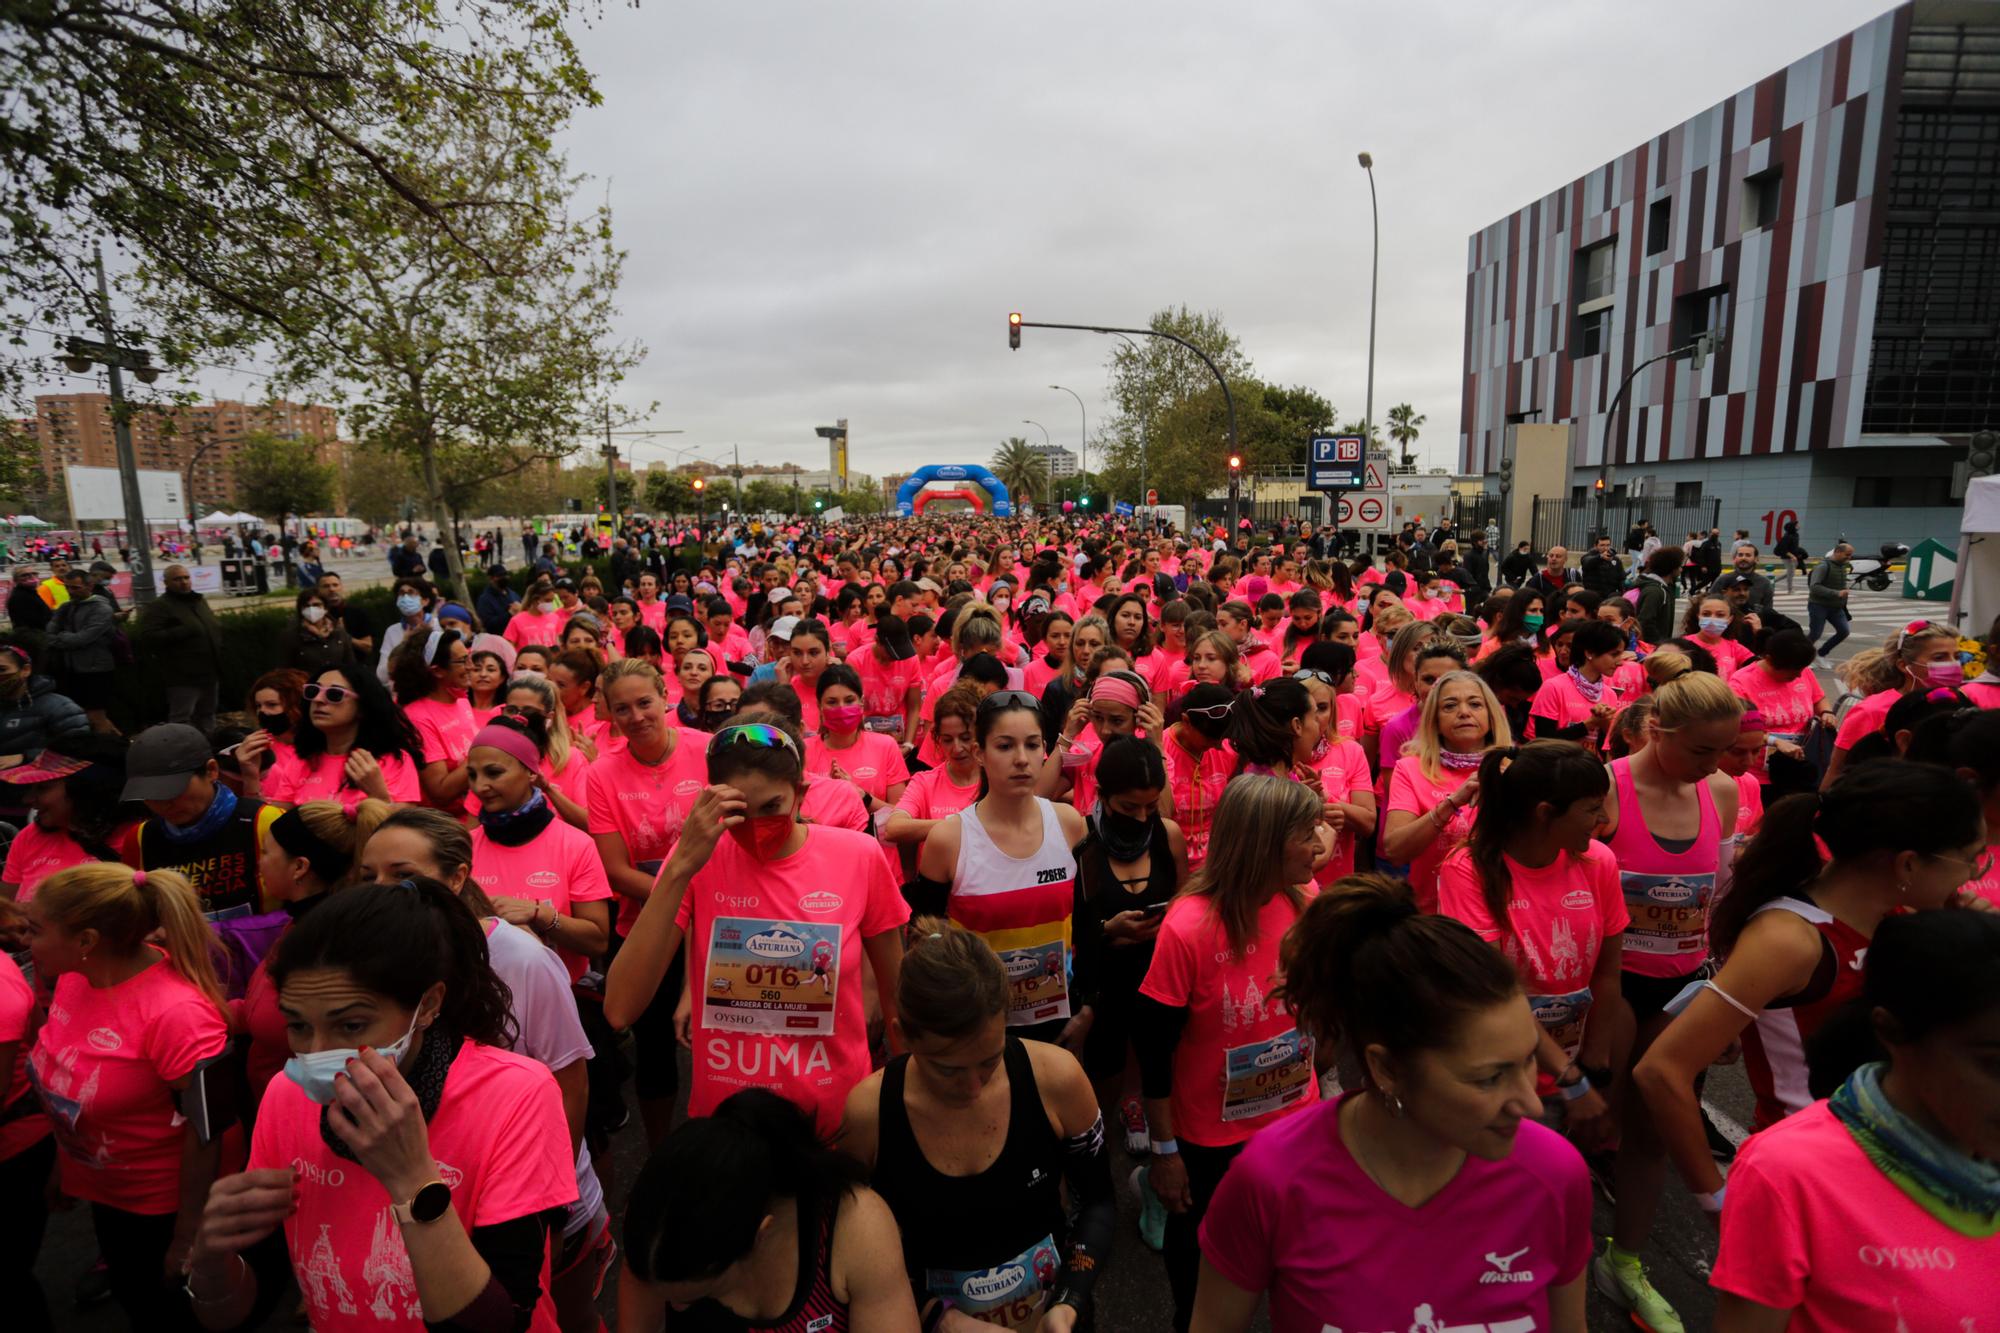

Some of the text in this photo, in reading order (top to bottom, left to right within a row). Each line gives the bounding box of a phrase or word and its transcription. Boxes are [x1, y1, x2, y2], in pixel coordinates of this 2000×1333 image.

[1320, 442, 1357, 459] P 1B
[1761, 510, 1797, 545] 10
[172, 852, 246, 875] NNERS
[191, 863, 247, 887] ENOS
[1036, 867, 1067, 884] 226ERS
[194, 878, 248, 897] NCIA
[1647, 905, 1689, 921] 016
[749, 938, 801, 953] ASTURIANA
[1215, 943, 1256, 963] OYO
[745, 964, 799, 986] 016
[1007, 963, 1037, 973] TURIANA
[1014, 976, 1037, 994] 16
[760, 990, 781, 1000] 560
[730, 1000, 762, 1009] CARRERA
[784, 1003, 808, 1011] MUJER
[714, 1012, 755, 1025] OYSHO
[707, 1038, 832, 1077] SUMA
[1256, 1067, 1290, 1087] 016
[1858, 1244, 1956, 1270] OYSHO
[966, 1271, 1023, 1297] ASTURIANA
